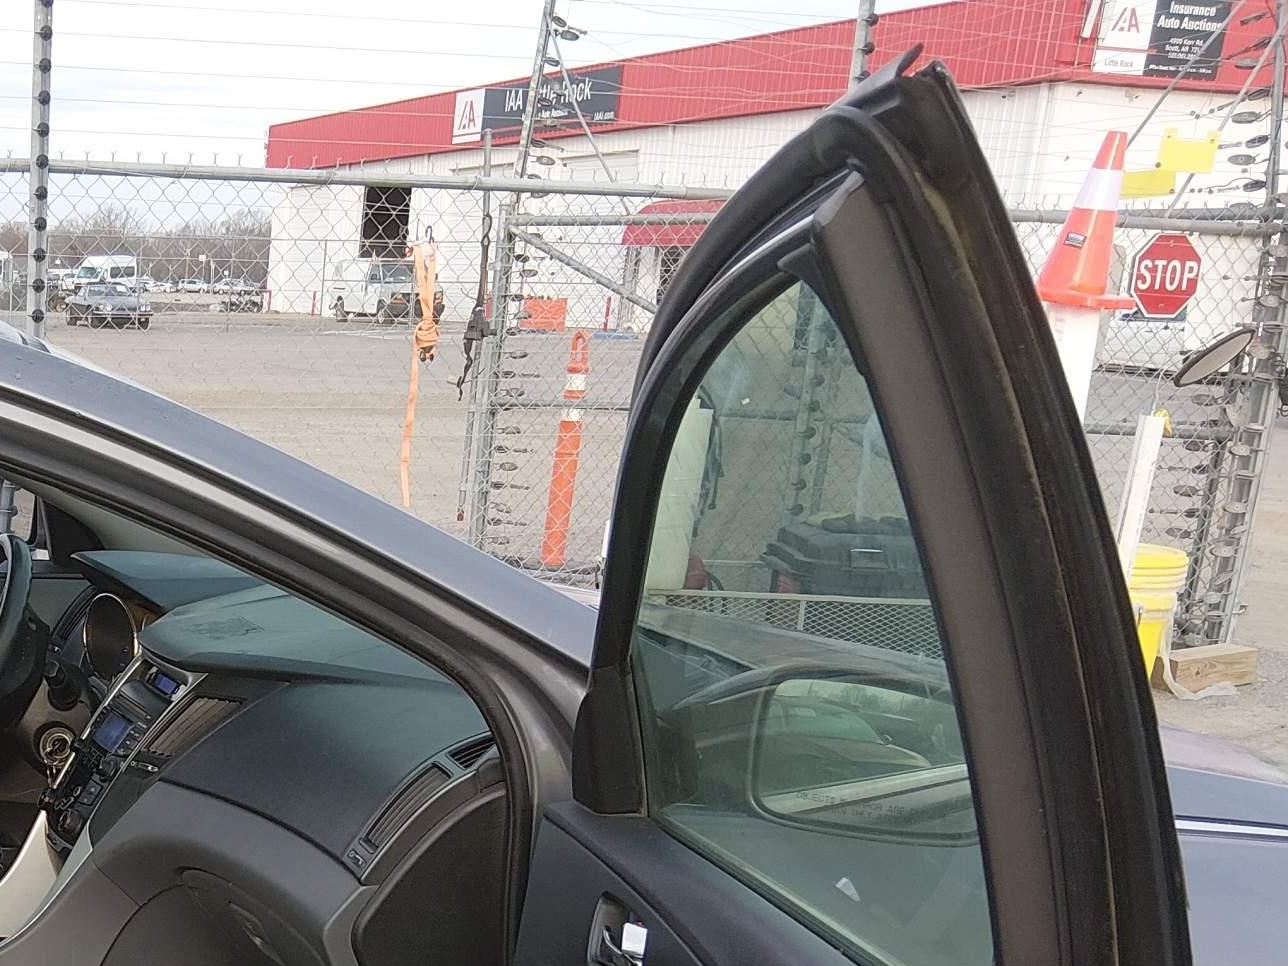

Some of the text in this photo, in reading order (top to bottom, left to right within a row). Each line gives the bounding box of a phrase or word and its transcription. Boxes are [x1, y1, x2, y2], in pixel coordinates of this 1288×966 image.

[1169, 1, 1217, 17] Insurance
[1157, 15, 1179, 30] Auto
[505, 88, 523, 112] IAA
[560, 77, 592, 104] Rock
[1137, 259, 1198, 291] STOP
